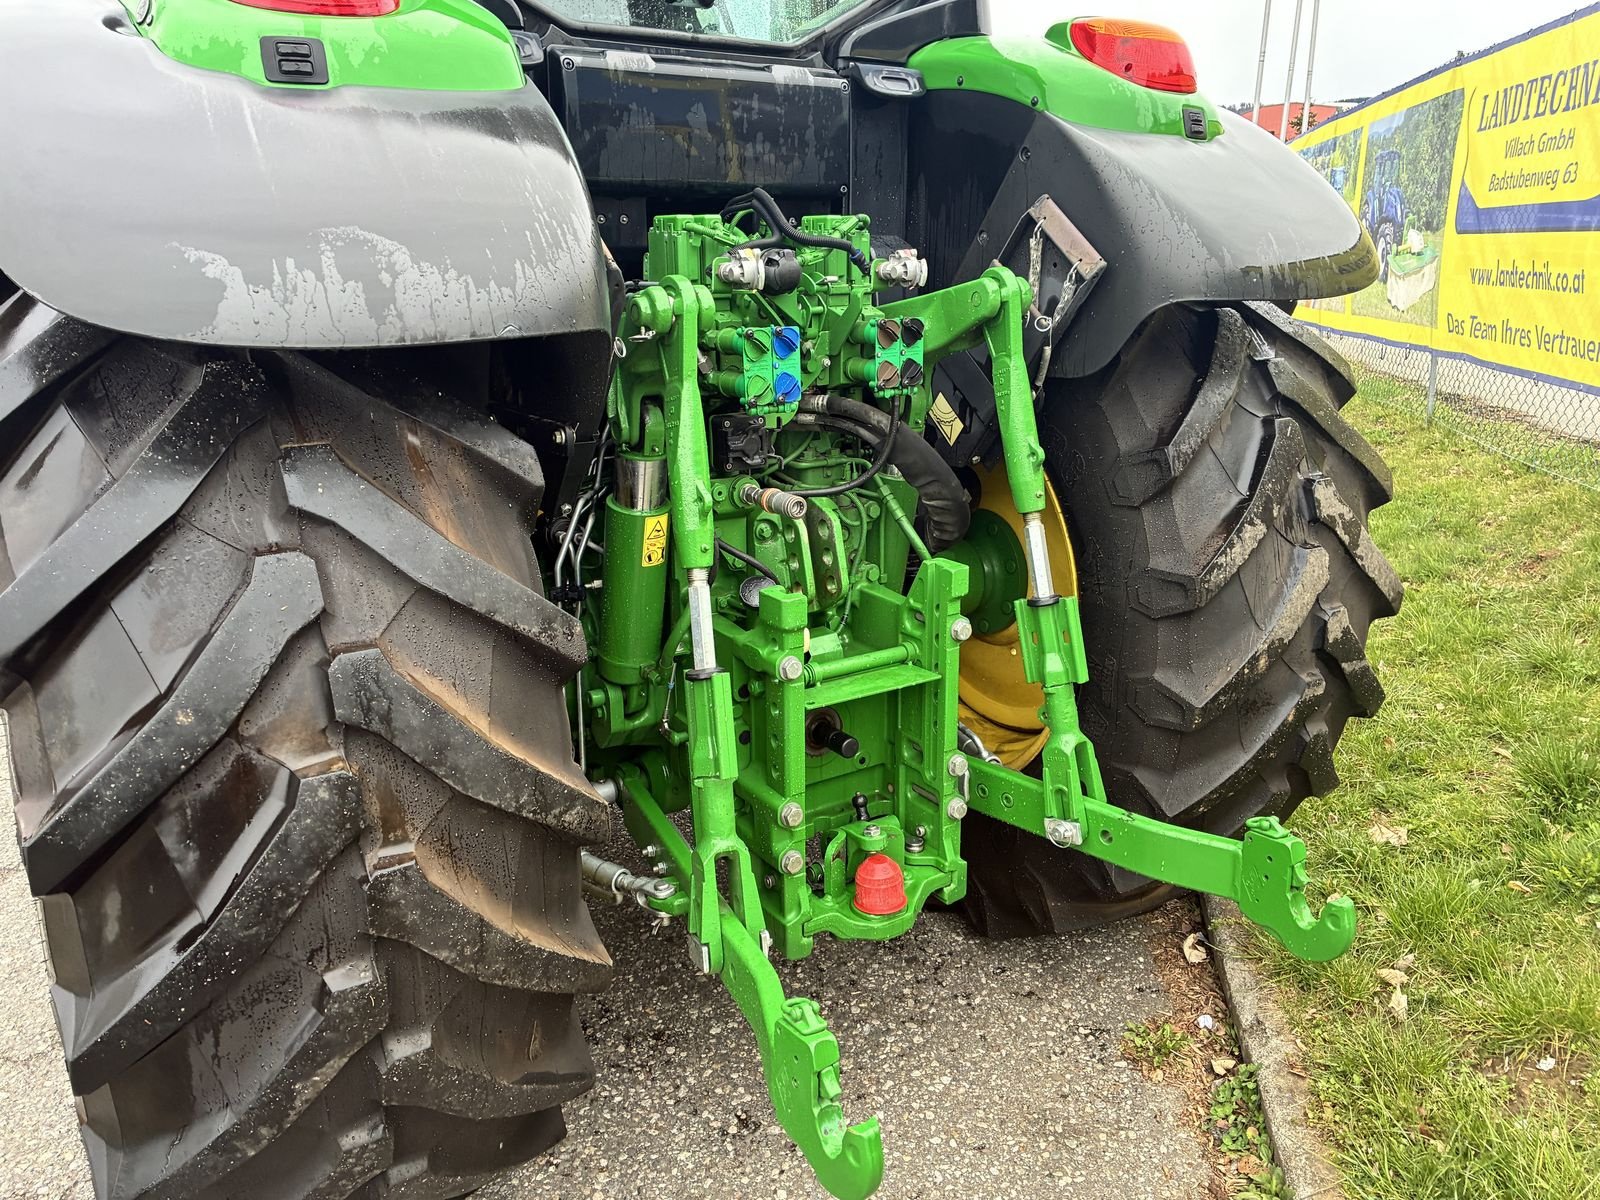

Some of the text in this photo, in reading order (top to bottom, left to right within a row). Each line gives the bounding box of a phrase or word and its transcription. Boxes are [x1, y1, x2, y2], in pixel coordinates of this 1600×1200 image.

[1504, 128, 1576, 159] Villach GmbH
[1488, 161, 1579, 192] Badstubenweg 63
[1469, 259, 1586, 294] www.landtechnik.co.at
[1446, 313, 1465, 336] Das
[1469, 315, 1497, 343] Team
[1501, 319, 1532, 348] Ihres
